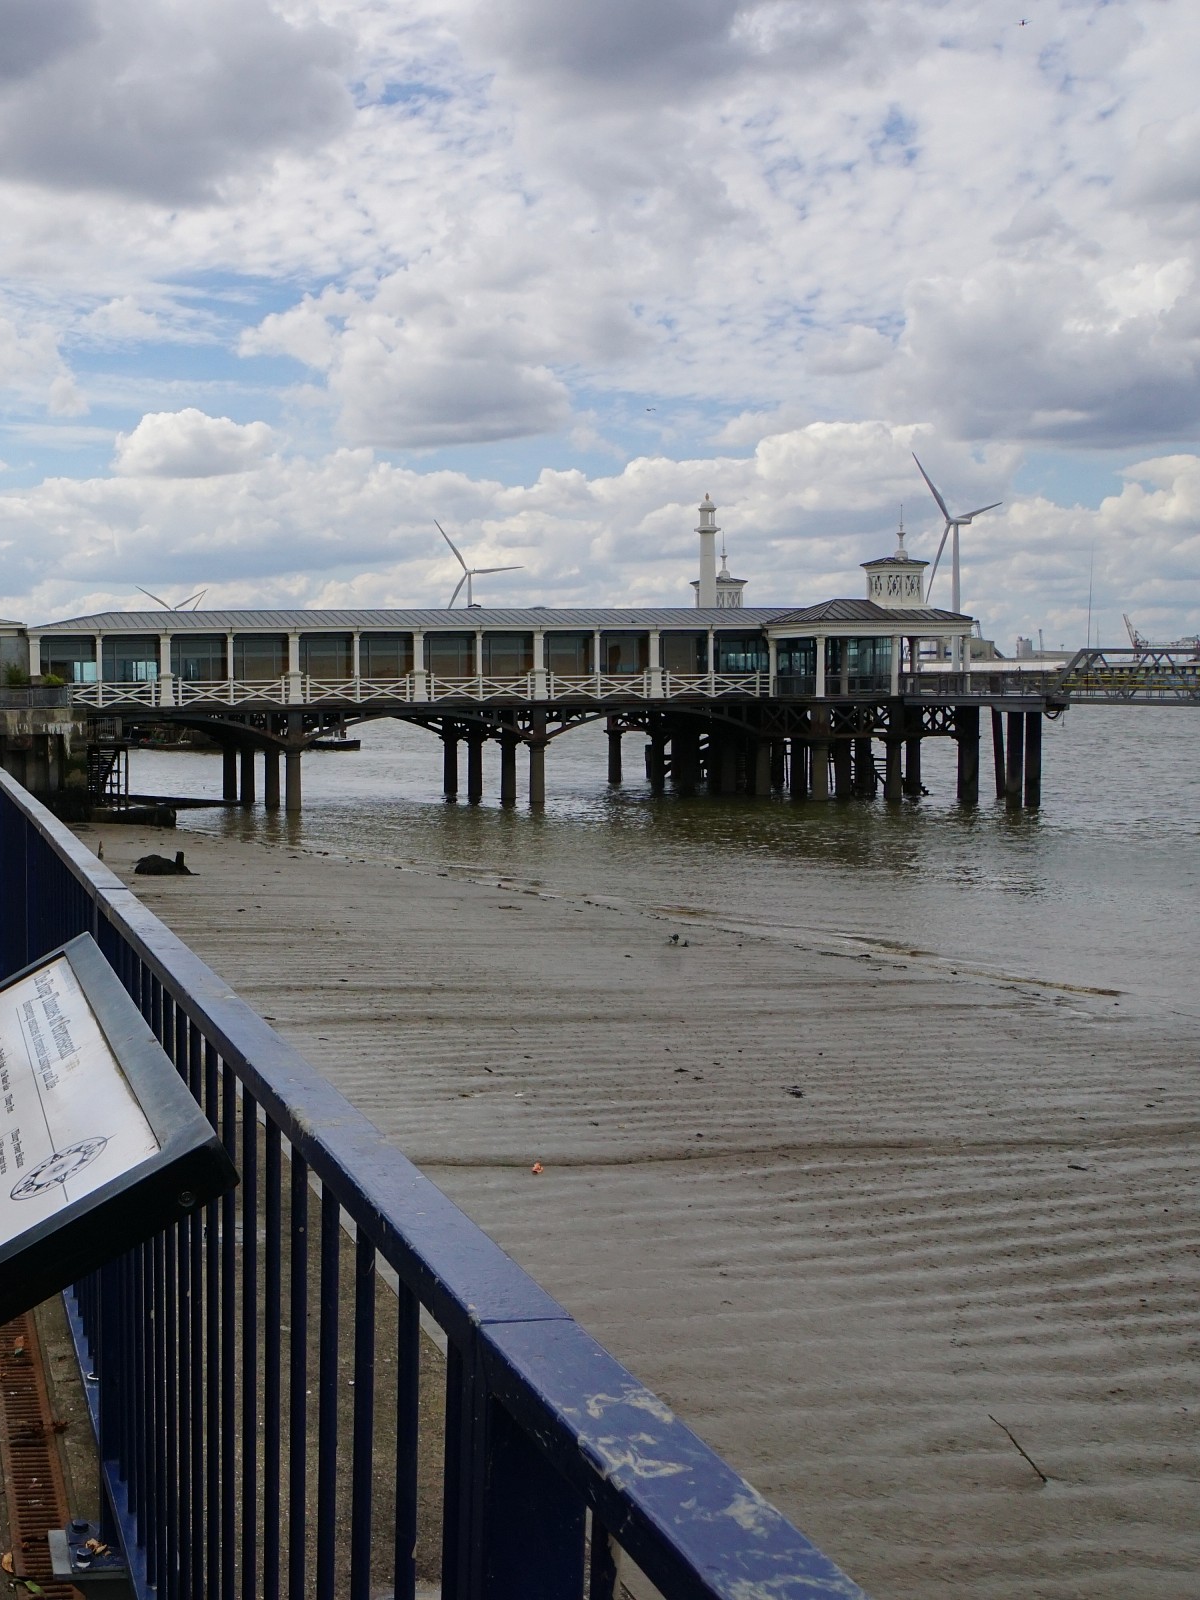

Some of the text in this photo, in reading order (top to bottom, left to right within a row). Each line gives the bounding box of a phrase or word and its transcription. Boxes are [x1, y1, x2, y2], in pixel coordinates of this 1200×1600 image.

[32, 969, 80, 1059] The River Thames at Gravesend
[42, 1070, 57, 1083] and
[45, 1076, 59, 1091] life
[4, 1093, 13, 1108] Tilbury
[10, 1128, 24, 1168] Tilbury Power Station
